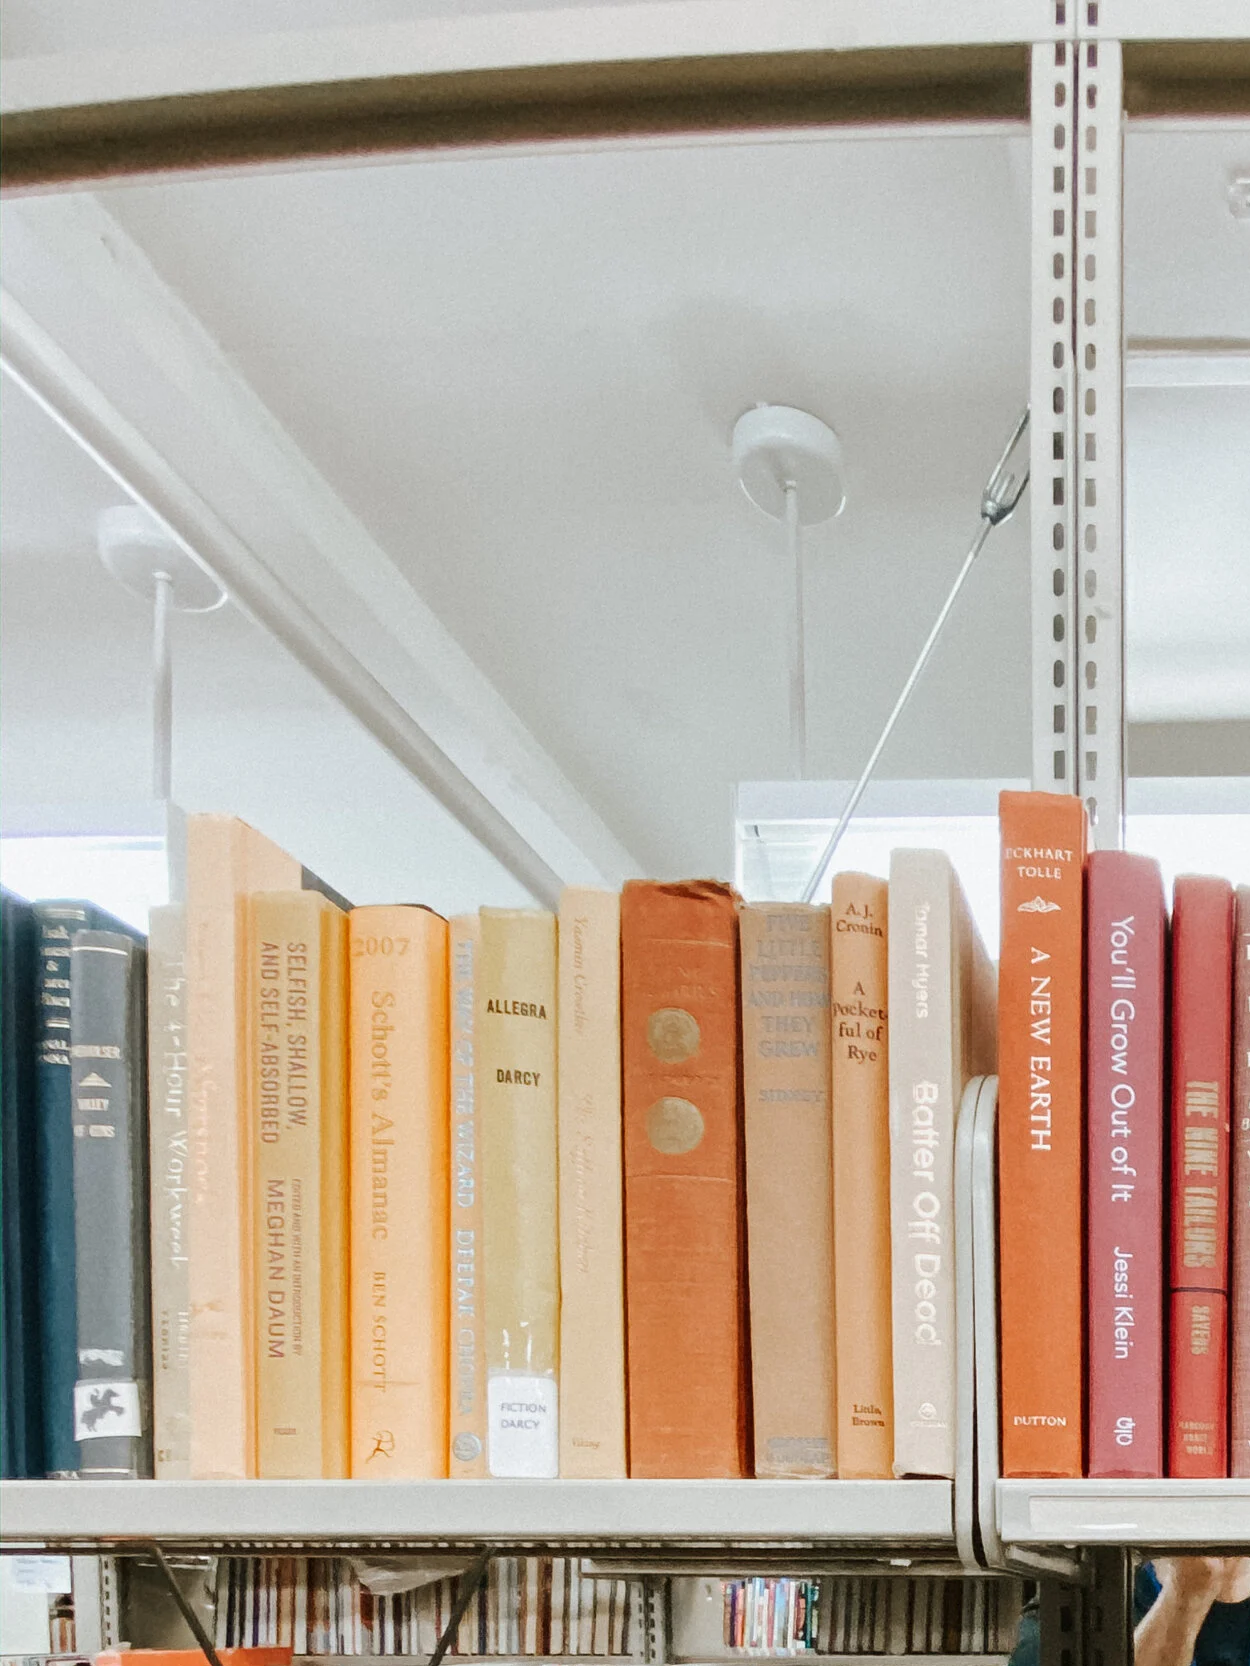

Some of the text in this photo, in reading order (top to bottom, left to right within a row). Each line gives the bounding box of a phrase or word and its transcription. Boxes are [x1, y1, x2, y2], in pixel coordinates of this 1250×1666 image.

[1017, 866, 1062, 879] TOLLE
[836, 920, 883, 937] Cronin
[352, 936, 411, 957] 2007
[261, 942, 280, 1000] AND
[487, 999, 547, 1019] ALLEGRA
[866, 1026, 883, 1041] of
[848, 1045, 877, 1064] Rye
[1030, 947, 1052, 1151] A NEW EARTH
[1110, 915, 1137, 1202] You'll Grow Out of It
[497, 1069, 541, 1087] DARCY
[908, 1192, 941, 1245] Off
[266, 1179, 285, 1358] MEGHAN DAUM
[1114, 1247, 1136, 1359] Jessi Klein
[501, 1403, 546, 1413] FICTION
[501, 1419, 539, 1430] DARCY
